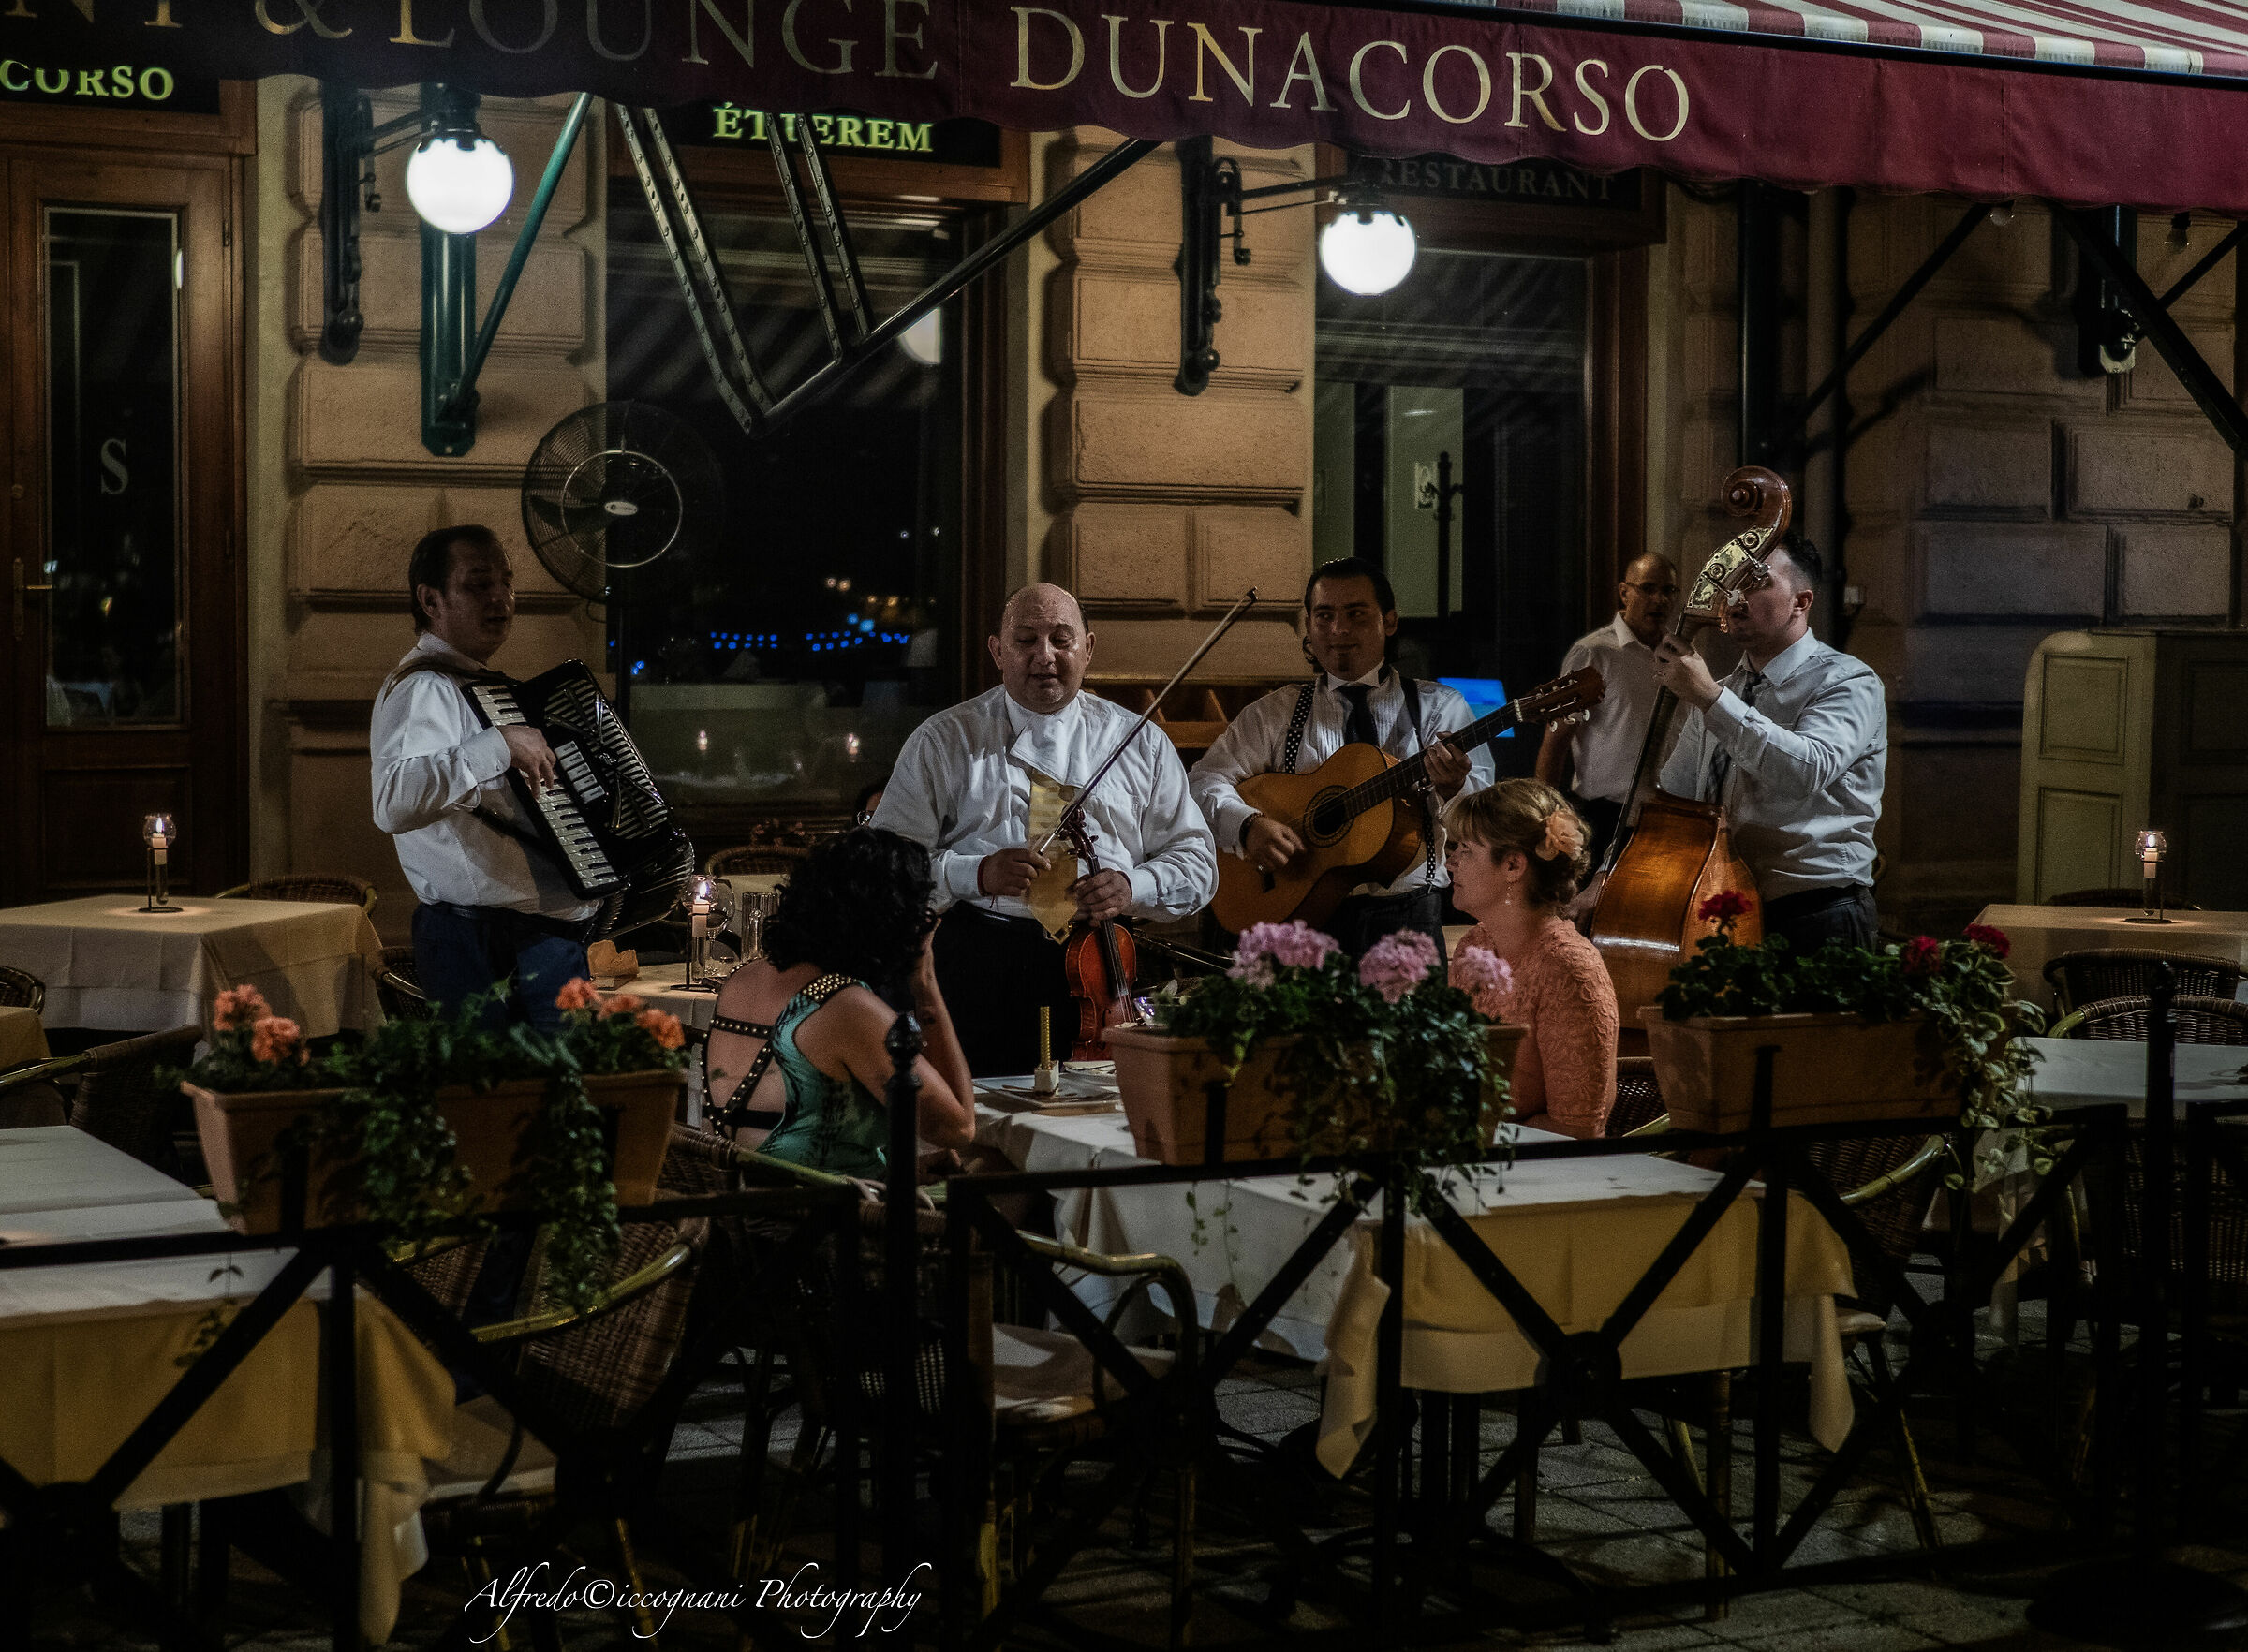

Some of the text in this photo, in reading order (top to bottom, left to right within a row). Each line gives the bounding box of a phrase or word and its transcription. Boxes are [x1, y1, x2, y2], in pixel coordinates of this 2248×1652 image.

[389, 0, 938, 80] LOUNGE
[1010, 7, 1690, 141] DUNACORSO
[100, 438, 128, 495] S
